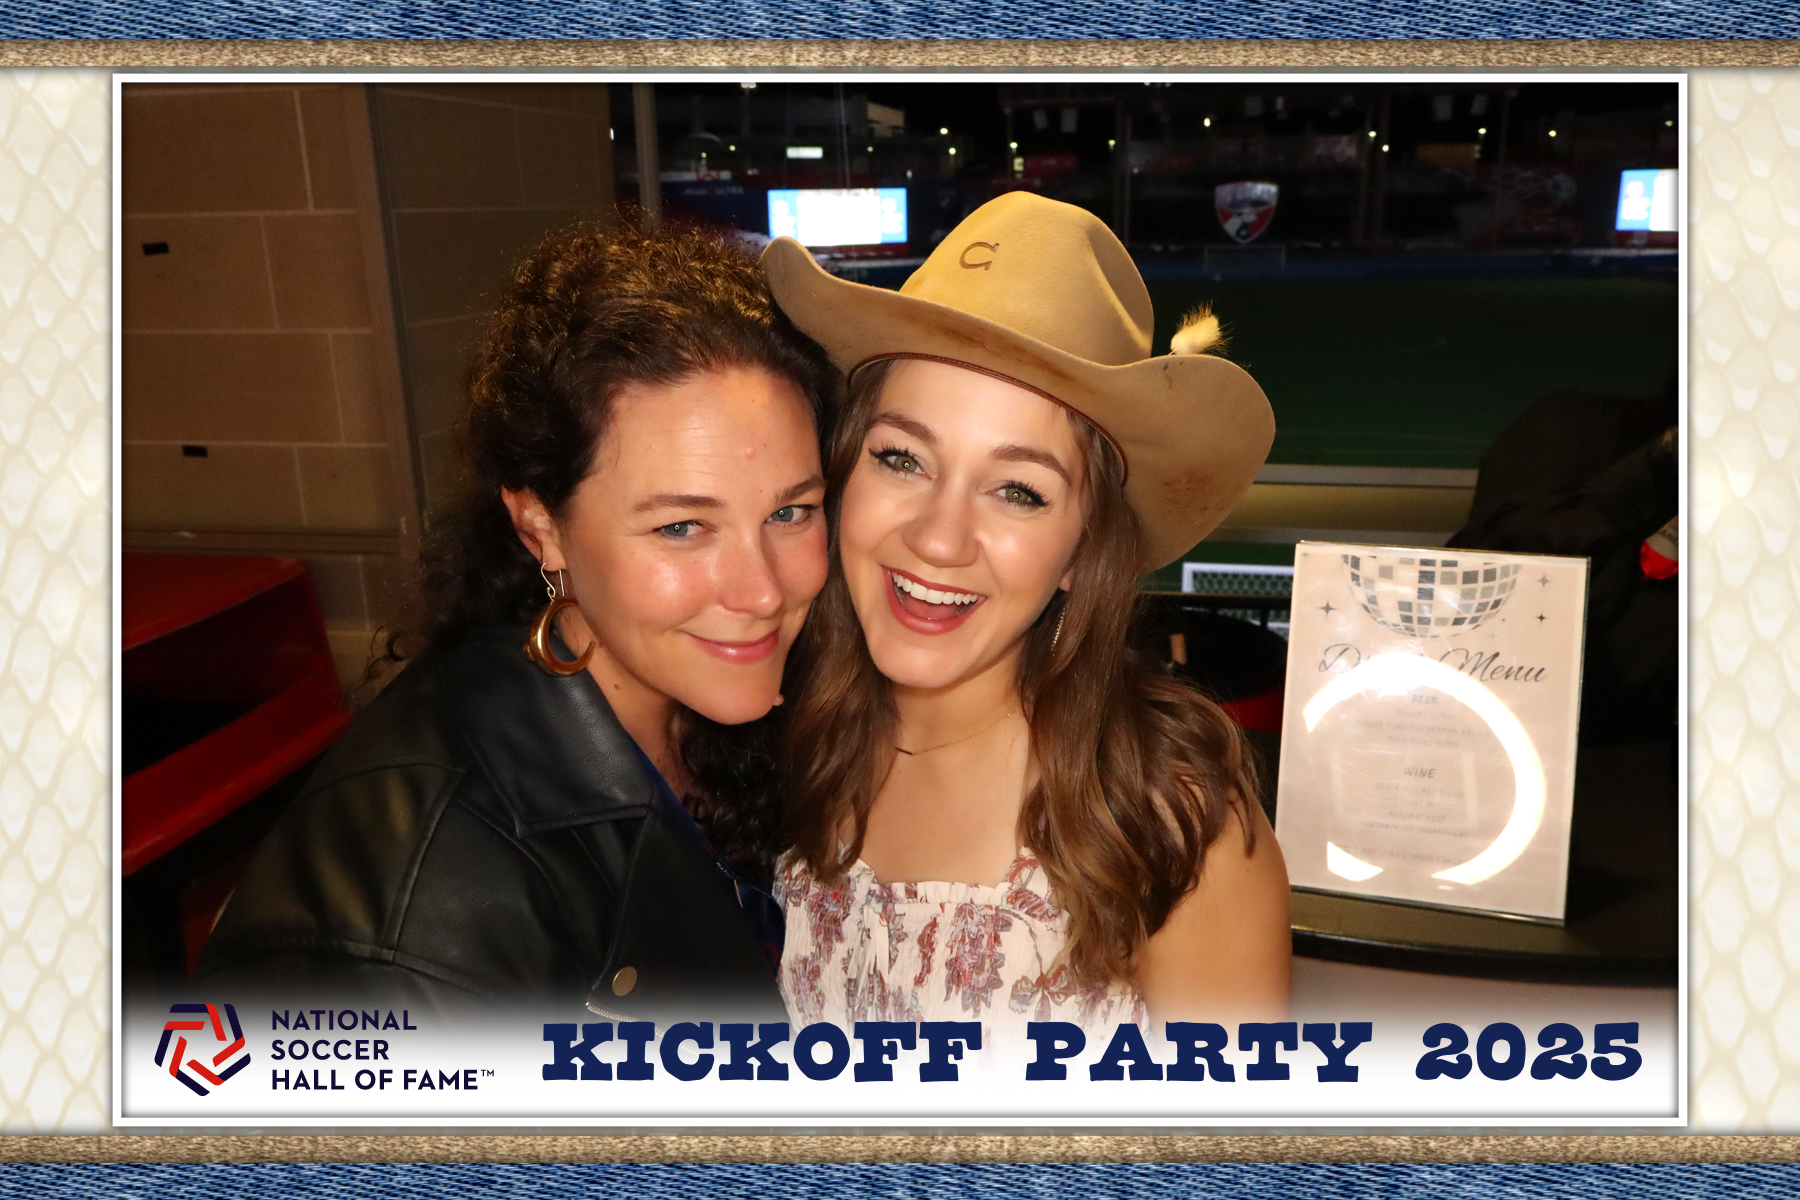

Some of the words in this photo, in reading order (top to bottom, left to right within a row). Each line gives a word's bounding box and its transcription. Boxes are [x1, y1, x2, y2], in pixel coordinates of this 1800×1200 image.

[1439, 647, 1548, 682] Menu
[1411, 693, 1439, 705] BEER
[1403, 766, 1437, 779] WINE
